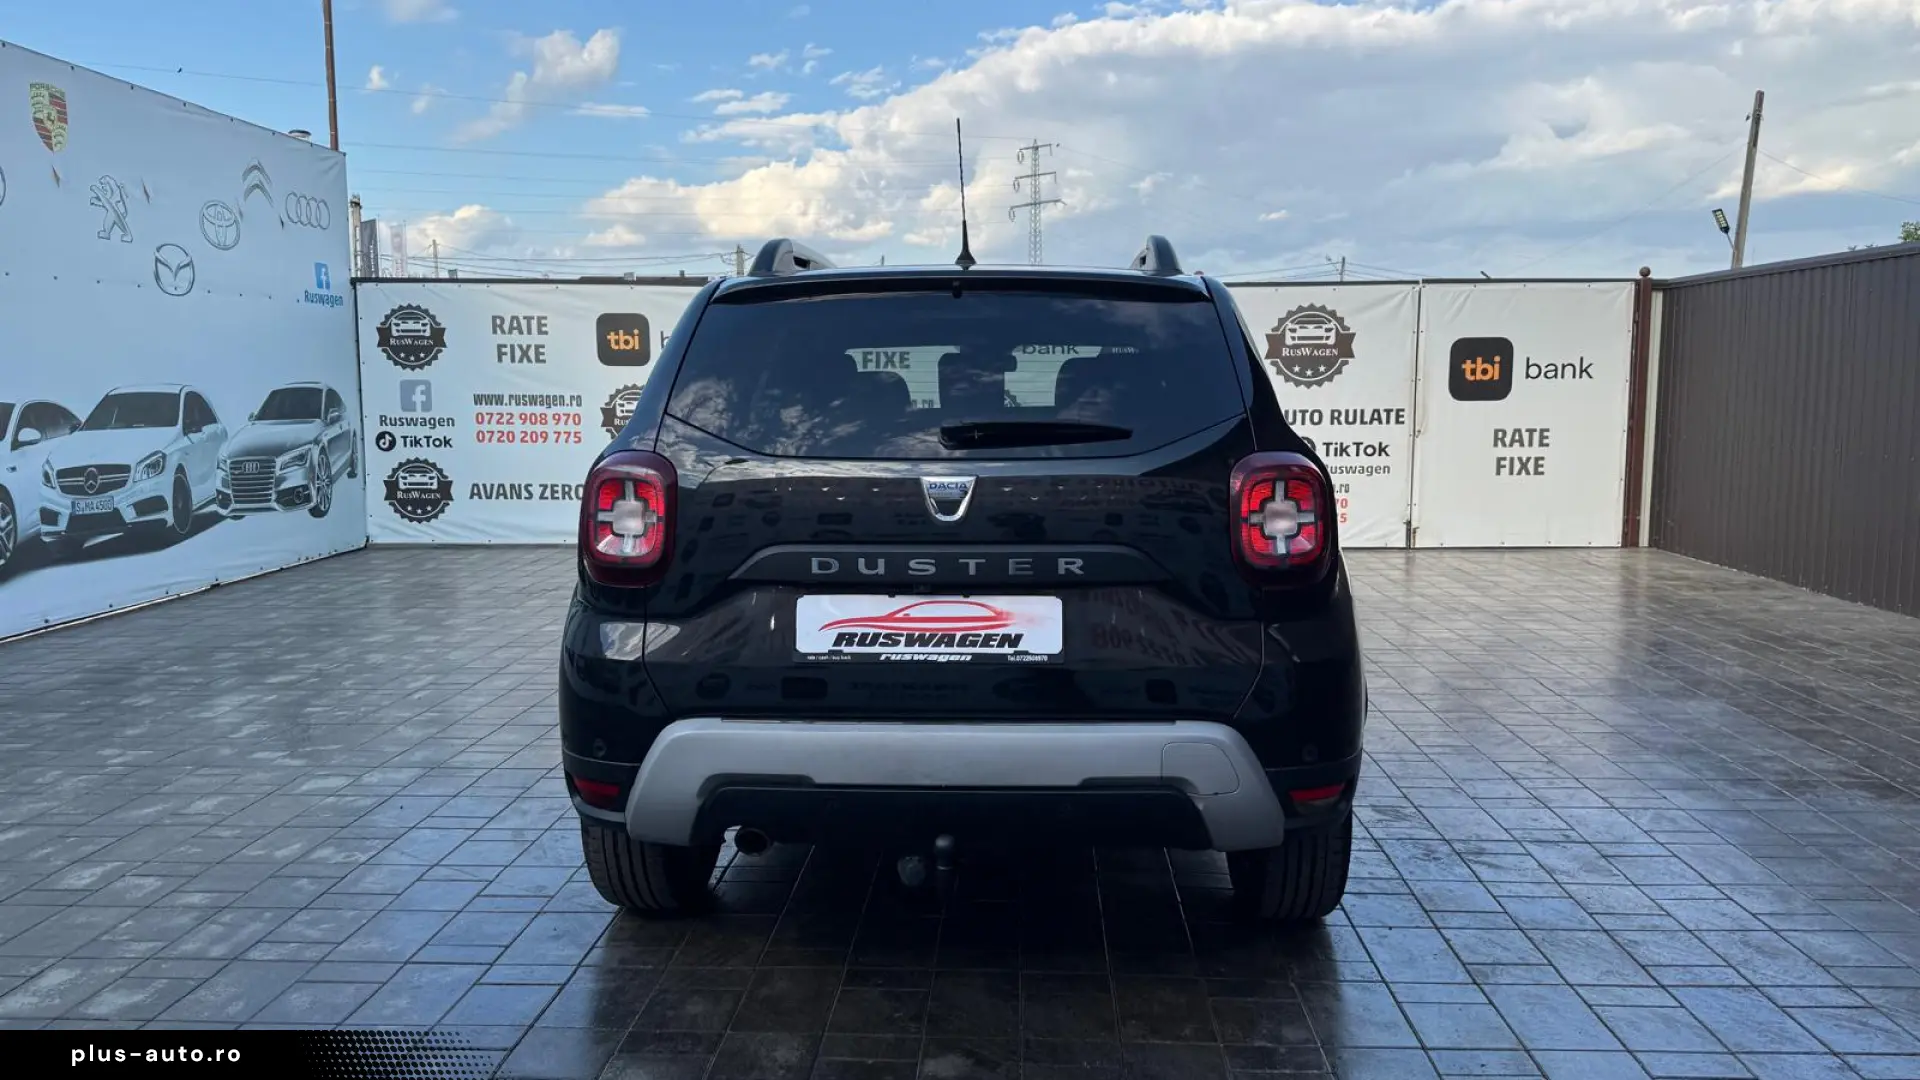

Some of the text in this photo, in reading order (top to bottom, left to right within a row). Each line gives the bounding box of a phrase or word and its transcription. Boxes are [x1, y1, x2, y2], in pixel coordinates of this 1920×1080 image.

[304, 290, 343, 307] Ruswagen
[491, 315, 549, 335] RATE
[607, 329, 639, 350] tbi
[496, 343, 547, 364] FIXE
[862, 351, 911, 369] FIXE
[1461, 356, 1594, 381] tbi bank
[473, 393, 583, 409] www.ruswagen.ro
[379, 414, 455, 430] Ruswagen
[475, 412, 582, 426] 0722 908 970
[1283, 408, 1406, 426] UTO RULATE
[400, 435, 453, 449] TikTok
[475, 430, 582, 444] 0720 209 775
[1493, 428, 1550, 448] RATE
[1322, 441, 1391, 457] TikTok
[1326, 464, 1391, 476] uswagen
[1495, 456, 1546, 476] FIXE
[469, 482, 534, 500] AVANS
[929, 482, 967, 491] DACIA
[810, 557, 1085, 576] DUSTER
[832, 632, 1025, 649] RUSWAGEN
[879, 653, 973, 662] ruswagen
